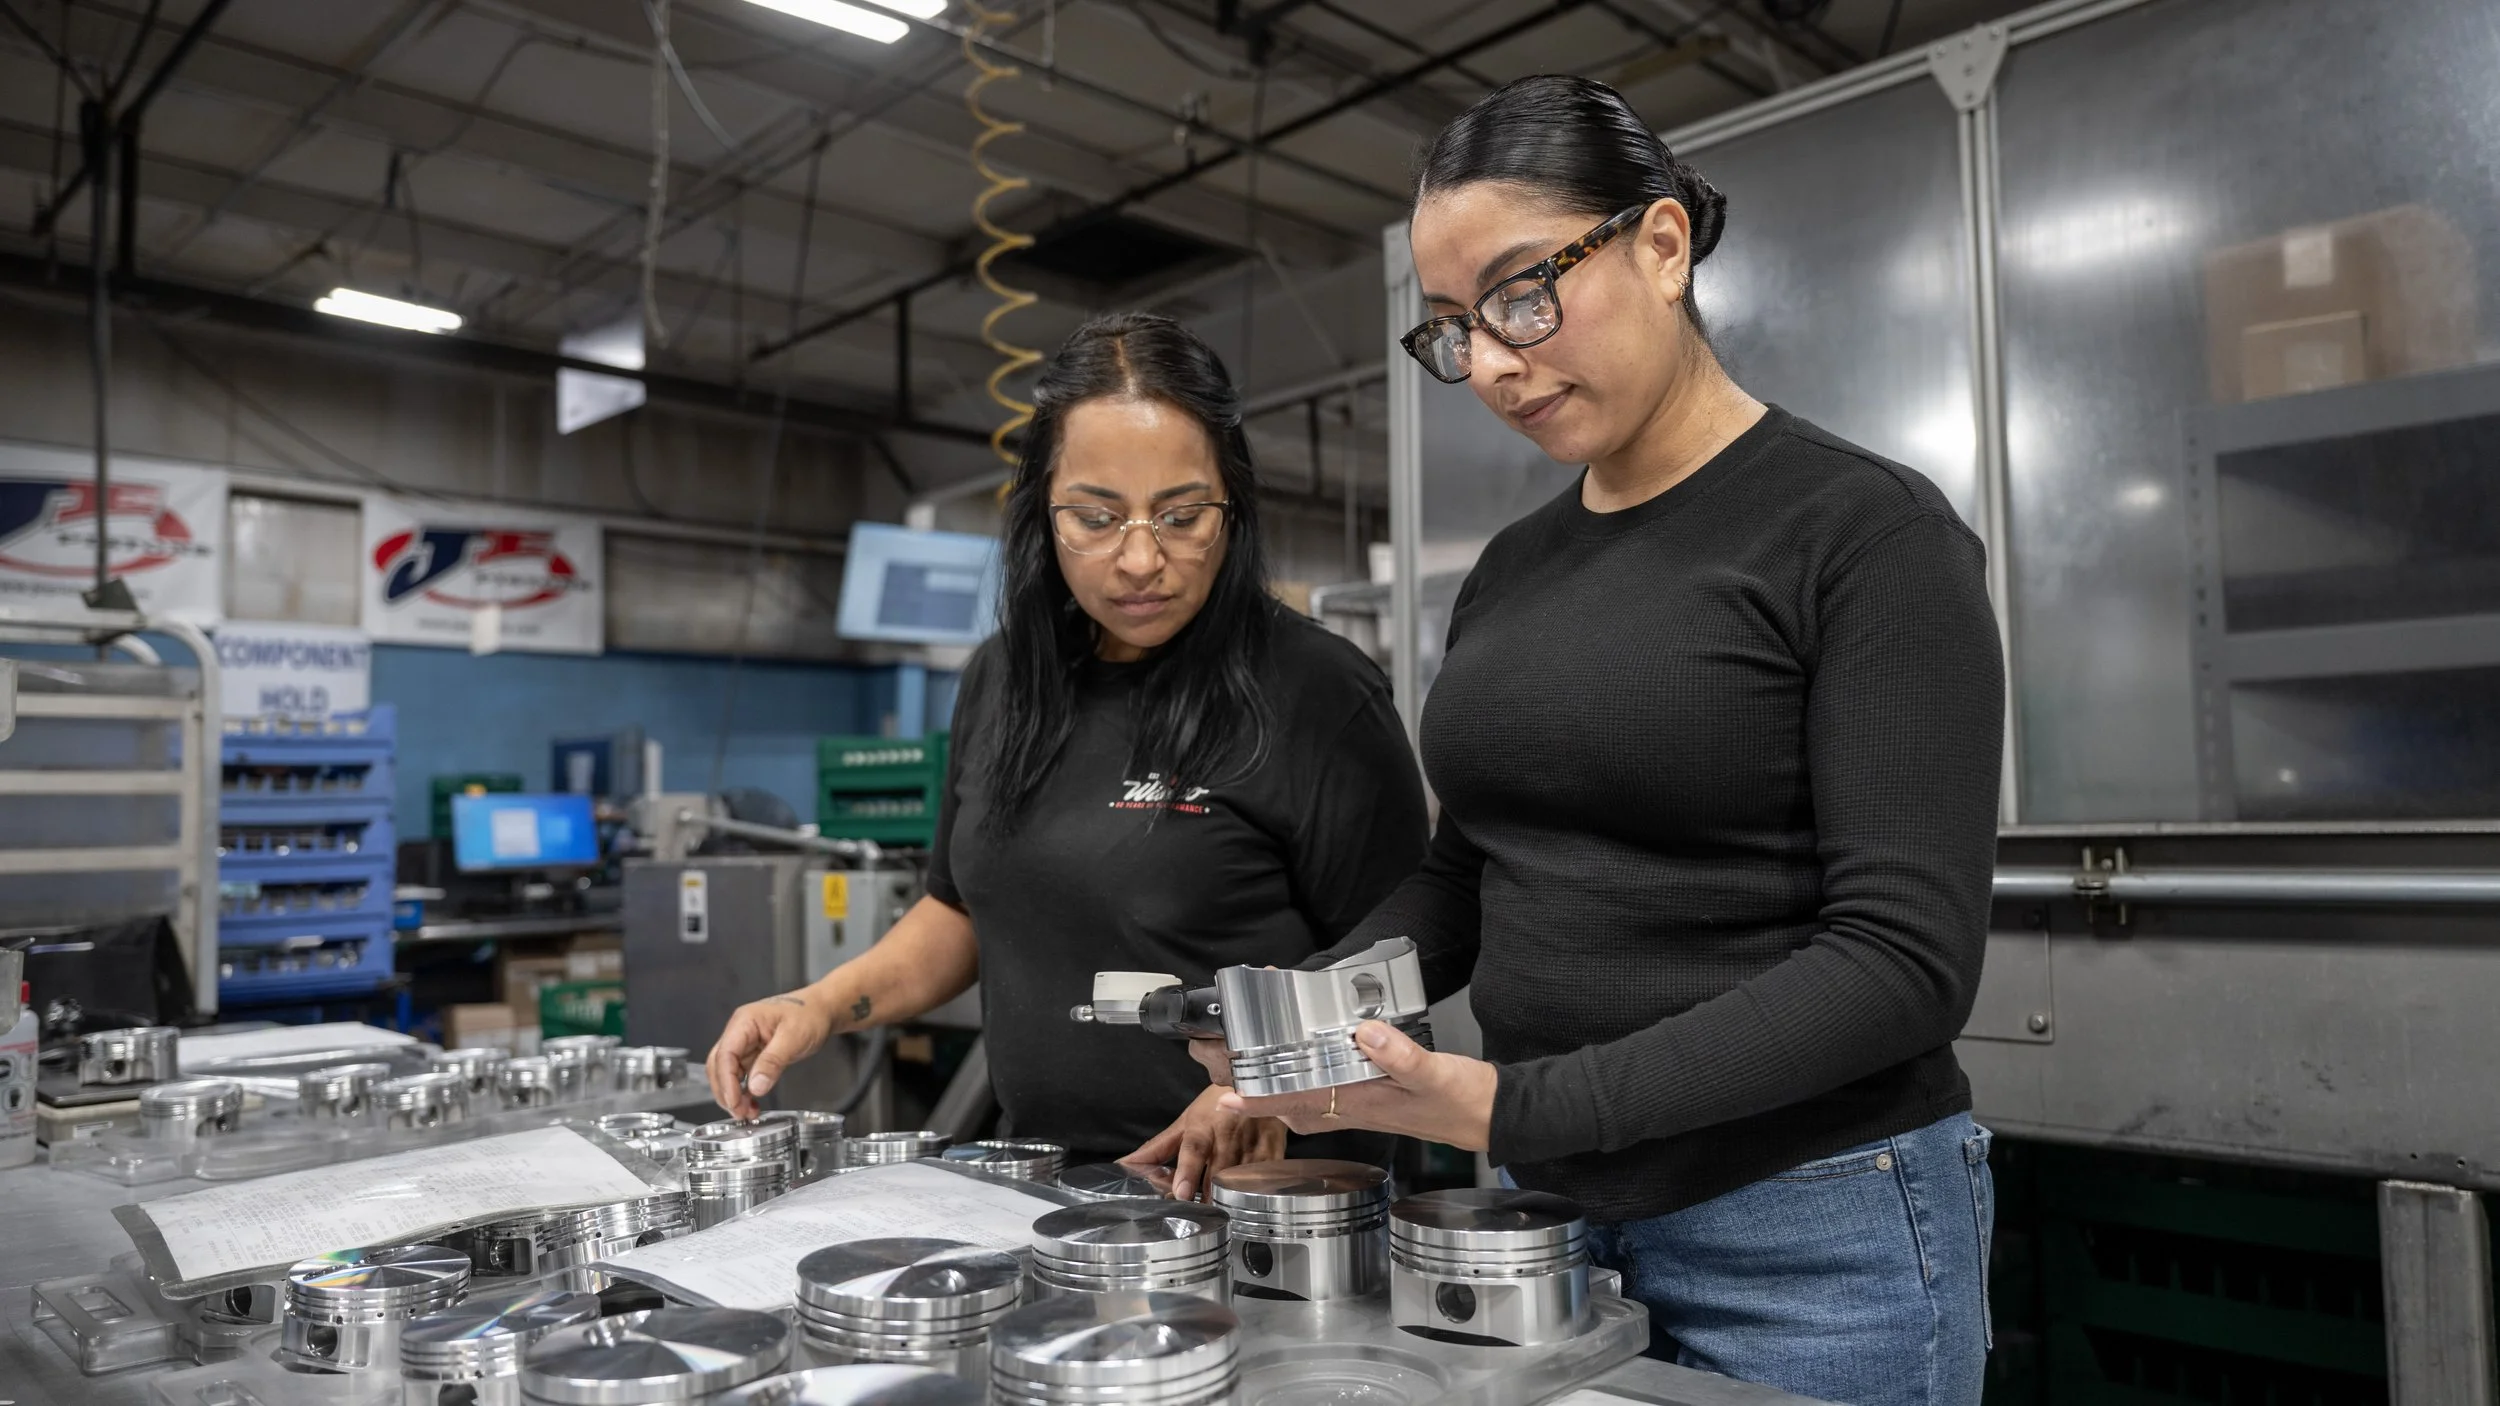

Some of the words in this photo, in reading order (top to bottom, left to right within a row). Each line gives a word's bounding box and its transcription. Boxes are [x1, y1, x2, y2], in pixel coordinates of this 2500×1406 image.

[213, 636, 371, 671] COMPONENT
[259, 685, 330, 715] HOLD
[1125, 801, 1146, 809] YEARS
